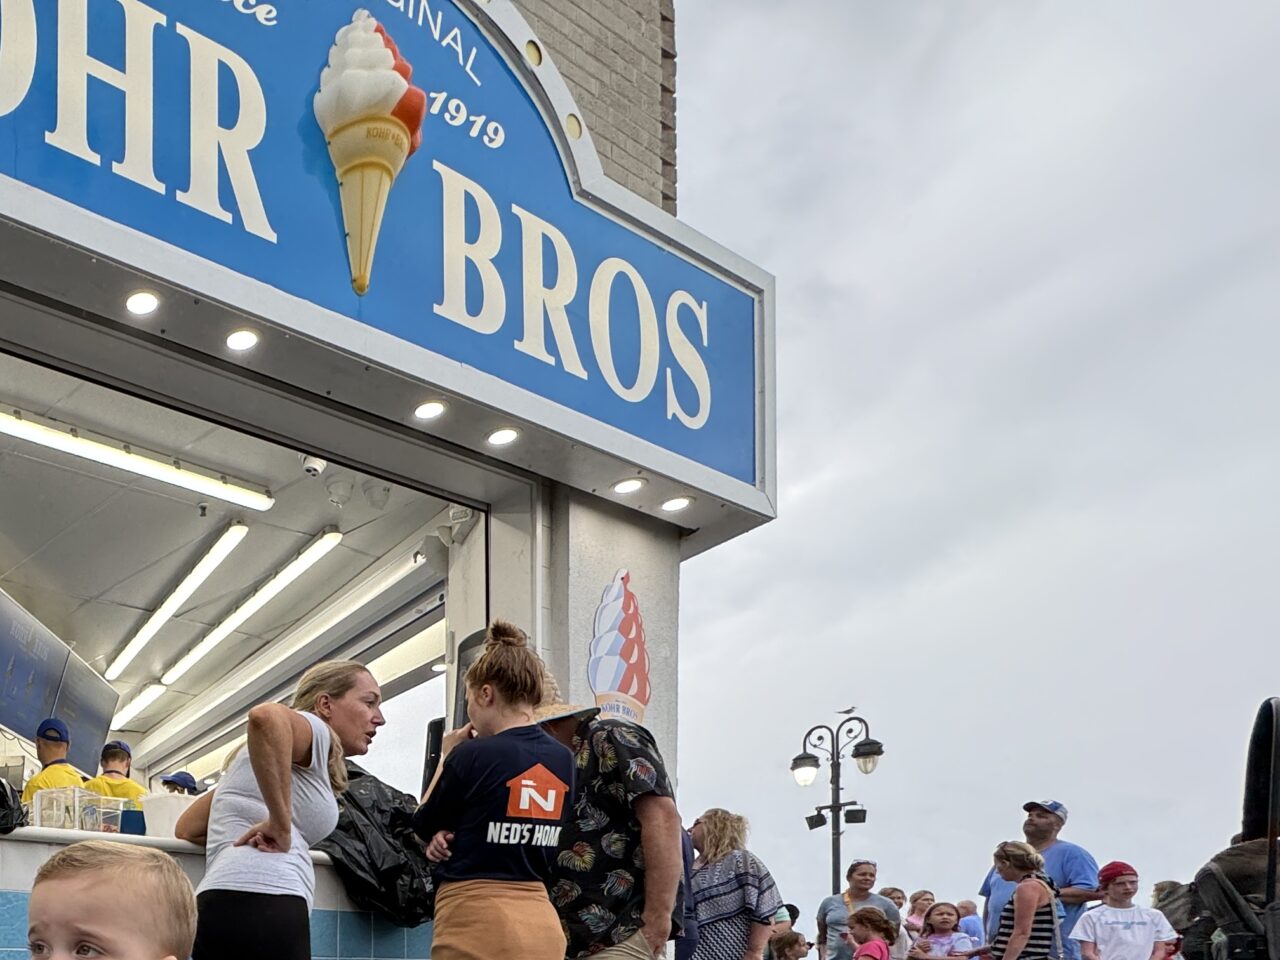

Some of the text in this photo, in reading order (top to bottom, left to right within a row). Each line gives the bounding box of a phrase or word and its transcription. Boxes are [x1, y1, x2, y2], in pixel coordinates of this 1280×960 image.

[223, 0, 277, 26] ce
[429, 91, 505, 149] 1919
[432, 159, 711, 429] BROS
[486, 821, 533, 845] NED'S
